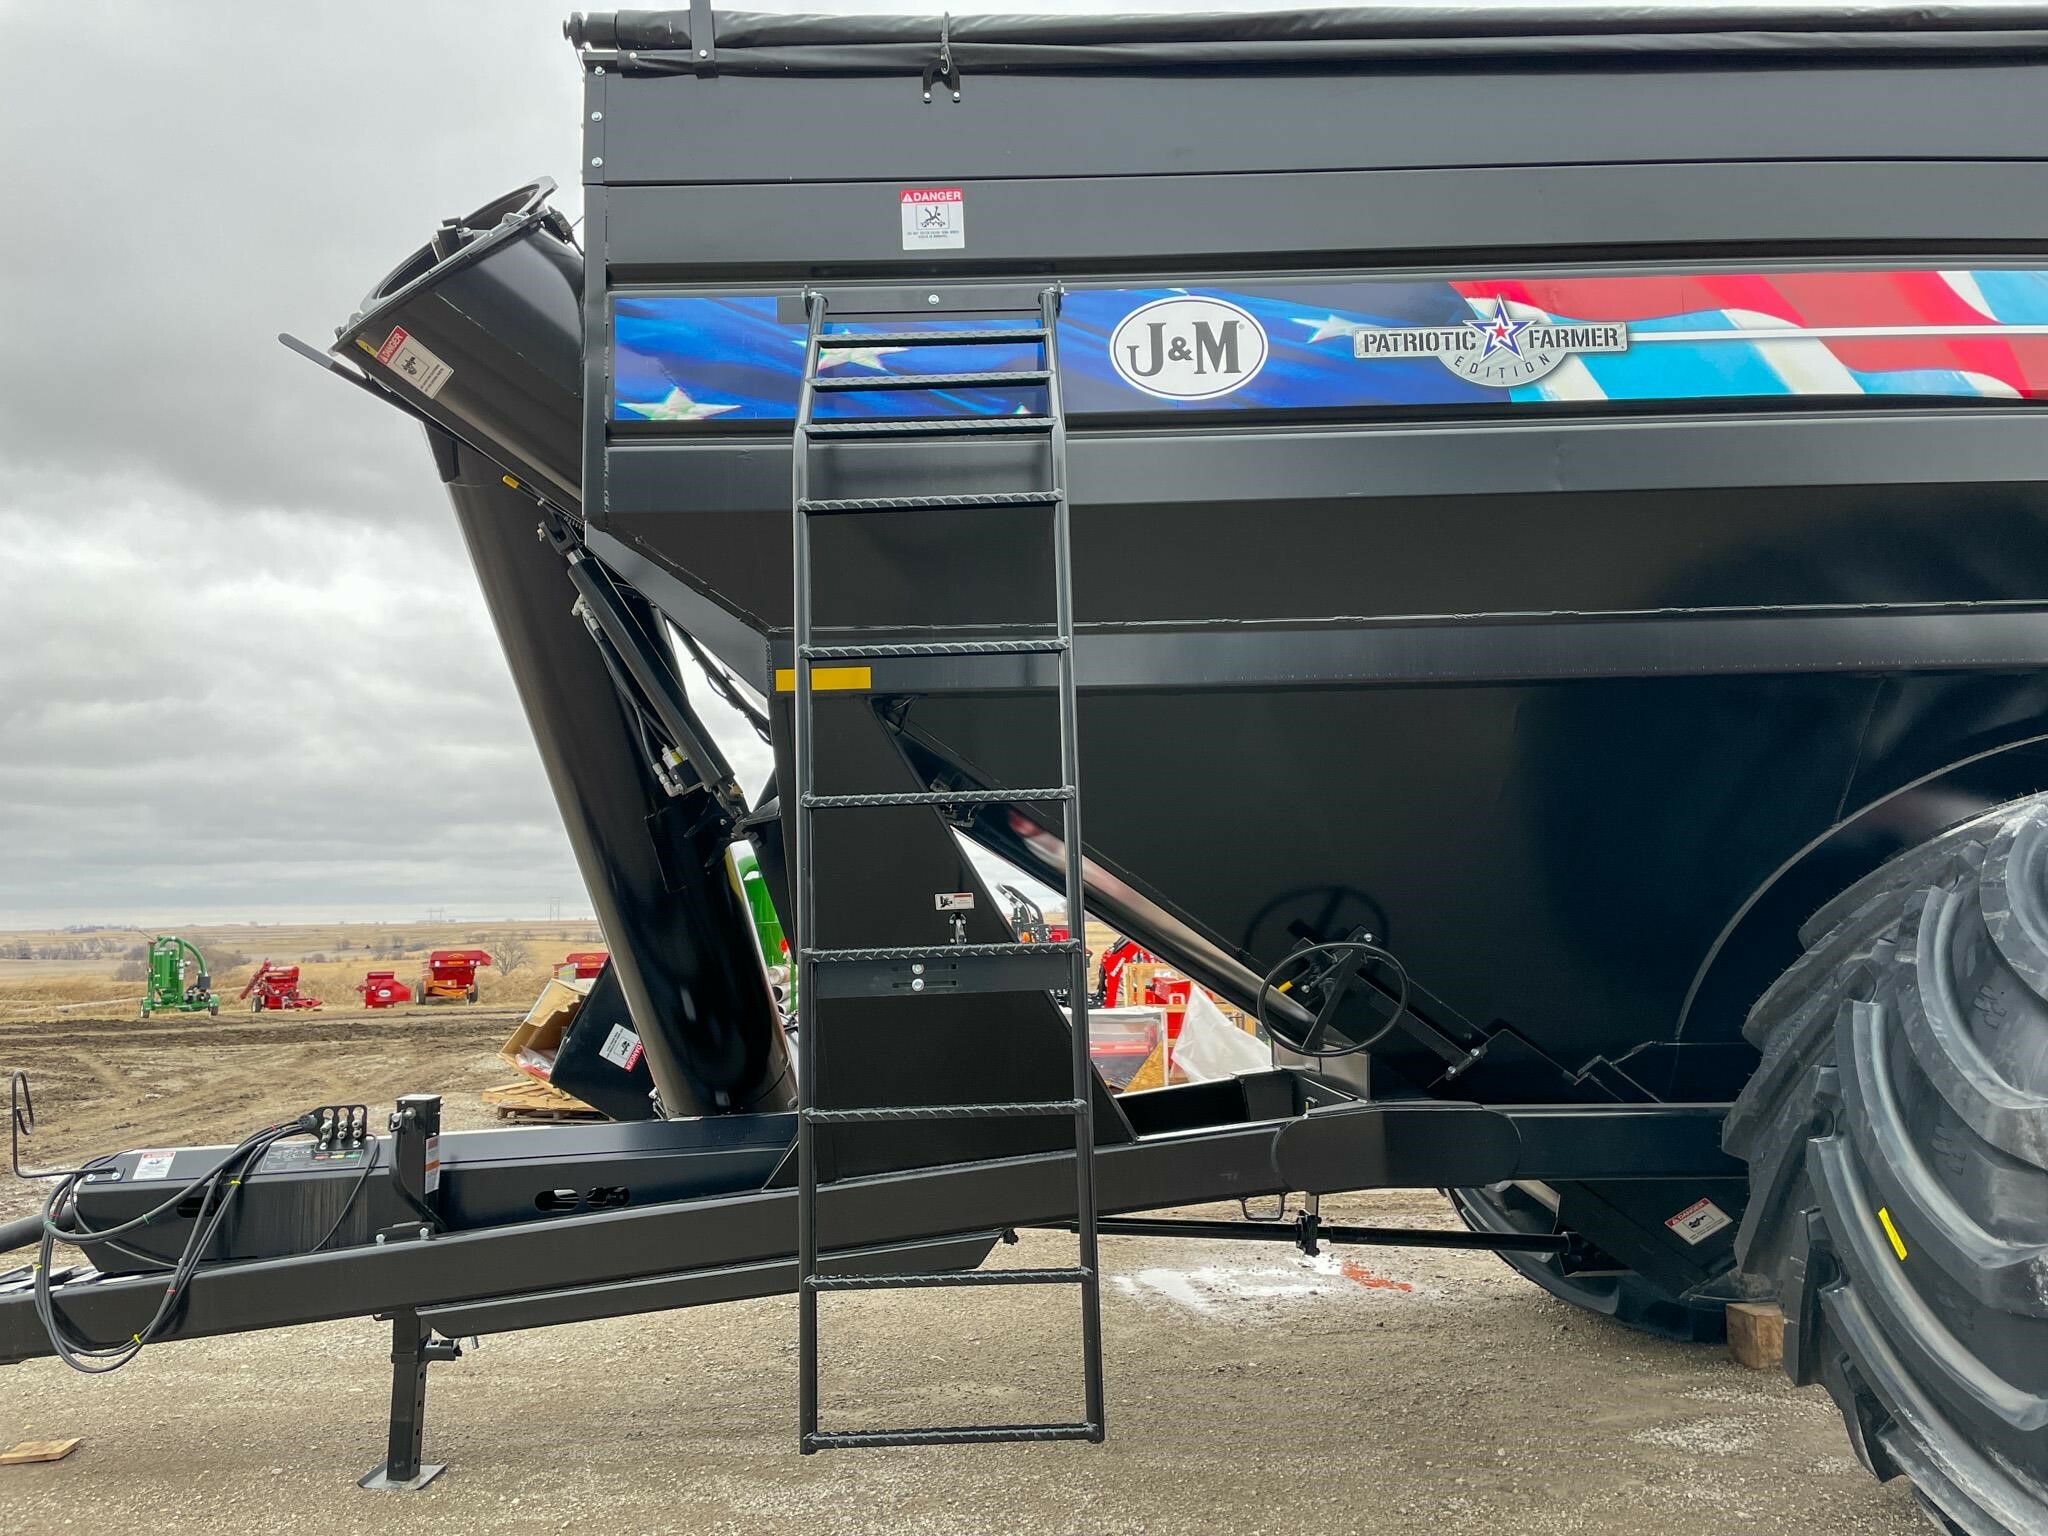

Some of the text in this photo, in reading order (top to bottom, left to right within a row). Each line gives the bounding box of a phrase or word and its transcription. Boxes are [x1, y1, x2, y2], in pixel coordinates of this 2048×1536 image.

[913, 191, 962, 202] DANGER
[1126, 320, 1242, 377] J&M
[1363, 327, 1619, 353] PATRIOTIC FARMER
[1453, 354, 1551, 379] EDITION
